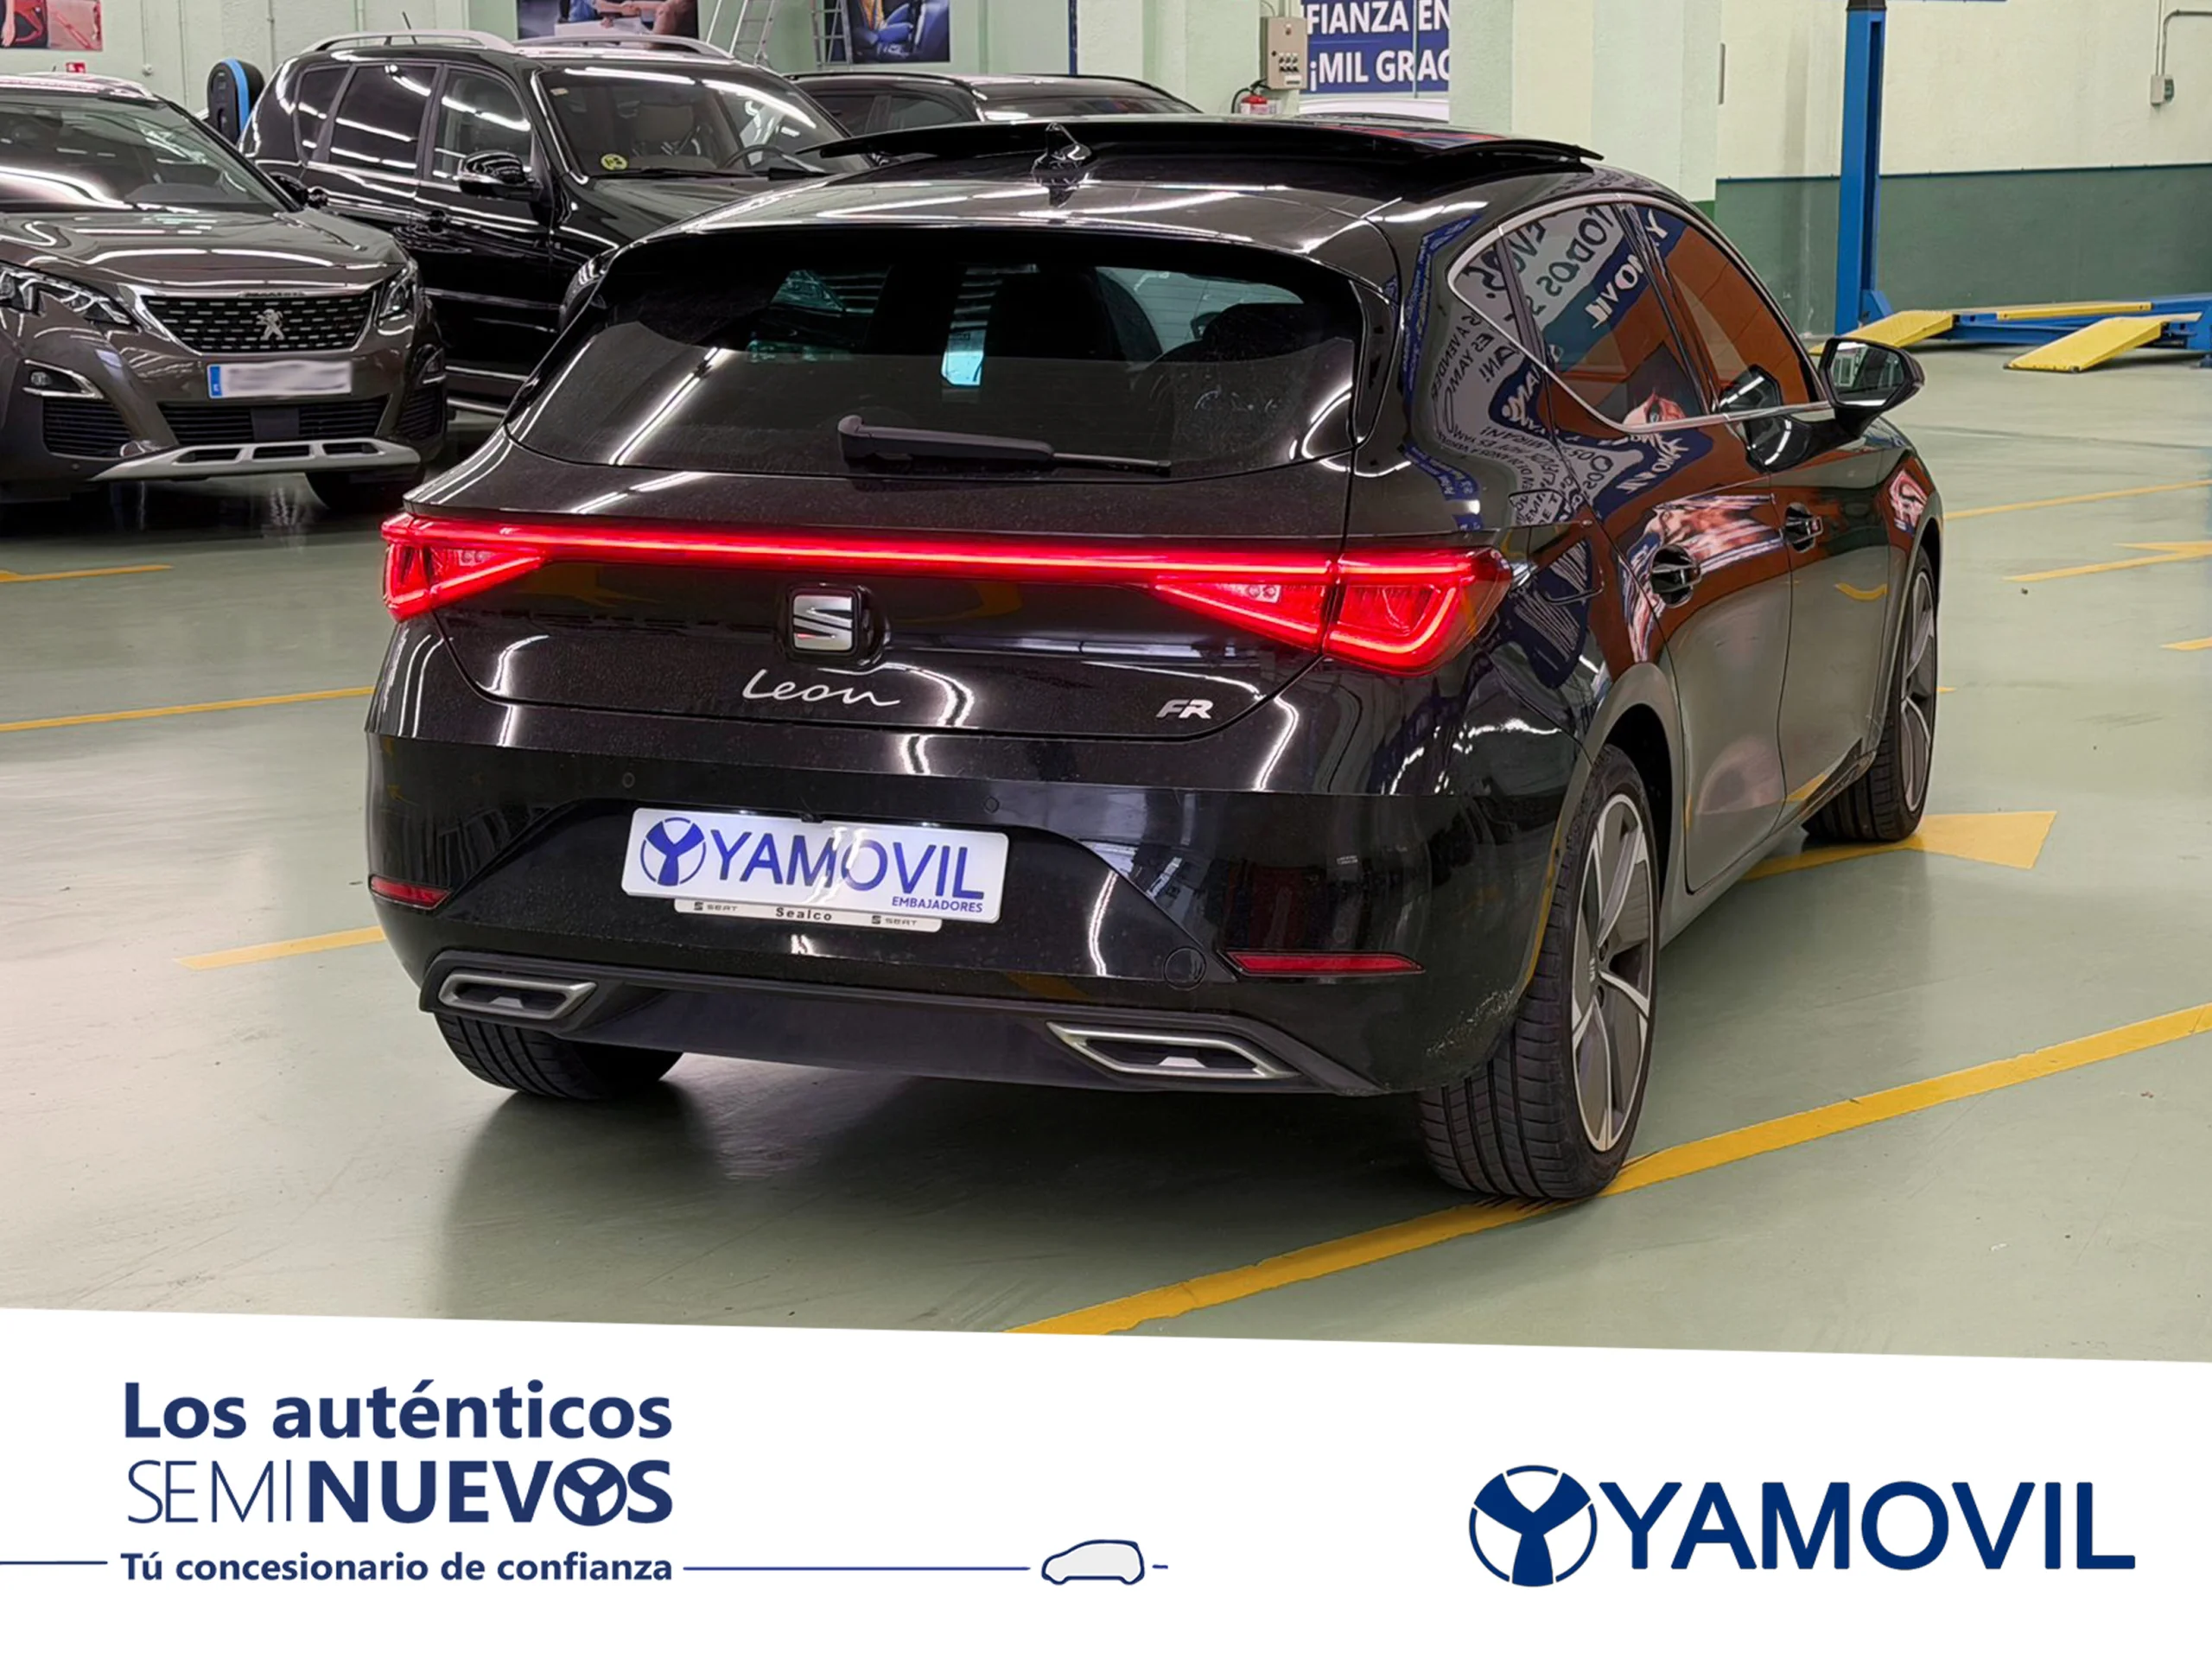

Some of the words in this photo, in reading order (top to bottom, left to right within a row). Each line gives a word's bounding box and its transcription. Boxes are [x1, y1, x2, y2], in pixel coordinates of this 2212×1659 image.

[1301, 1, 1409, 35] FIANZA
[1310, 52, 1369, 92] ¡MIL
[742, 669, 901, 706] Leon
[1155, 698, 1214, 719] FR
[710, 830, 985, 899] YAMOVIL
[775, 907, 832, 921] Sealco
[892, 896, 983, 913] EMBAJADORES
